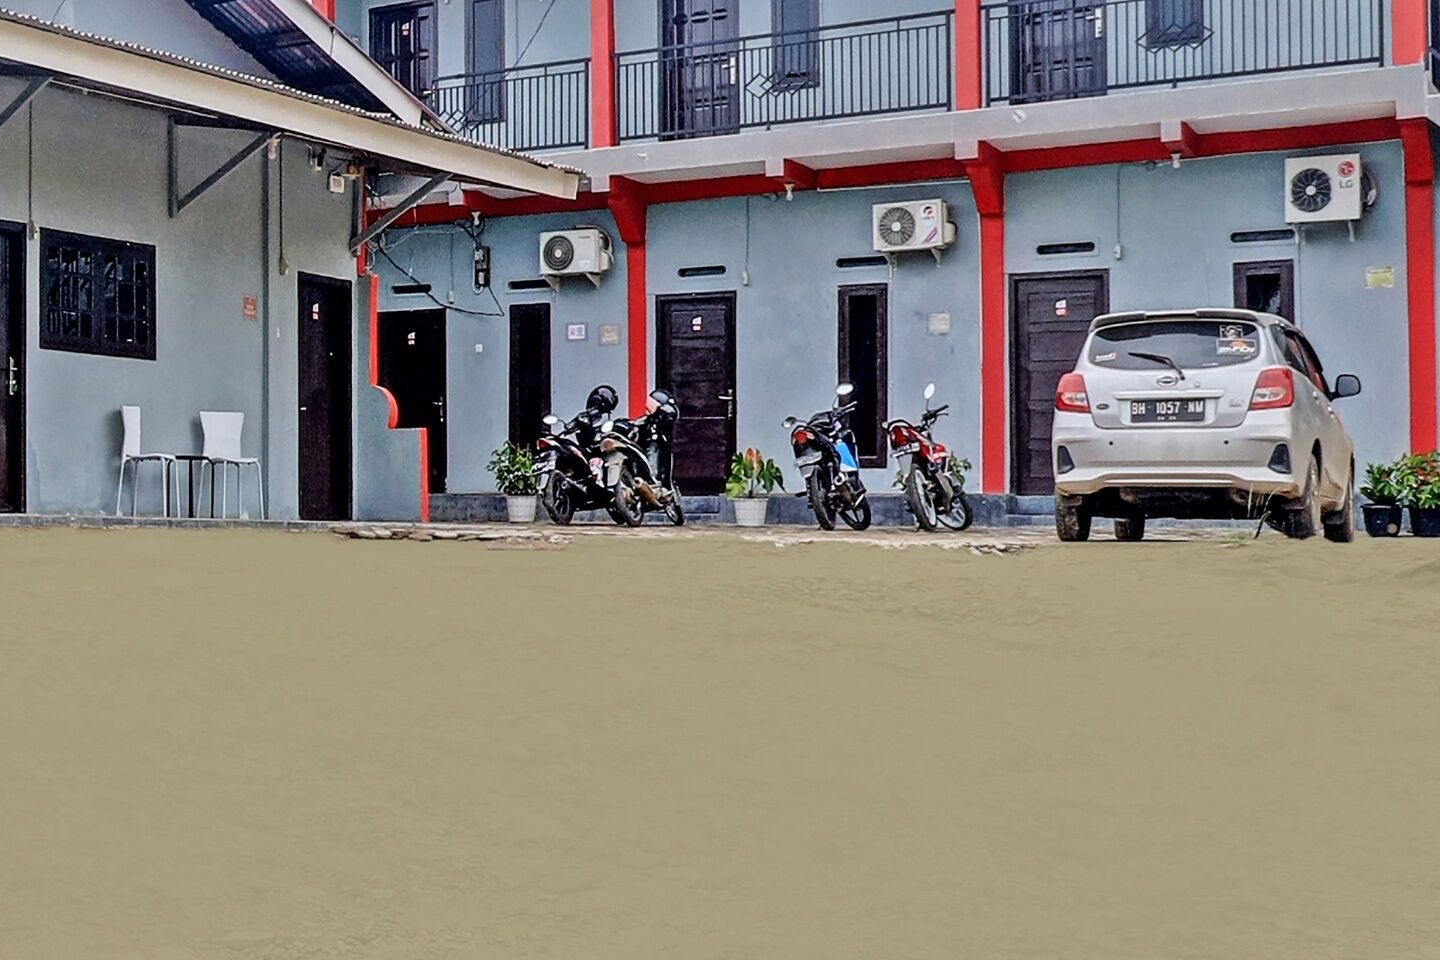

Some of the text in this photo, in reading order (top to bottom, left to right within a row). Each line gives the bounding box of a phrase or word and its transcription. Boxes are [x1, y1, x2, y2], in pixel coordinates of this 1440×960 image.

[1339, 179, 1353, 189] LG
[1131, 402, 1146, 415] BH
[1155, 401, 1181, 415] 1057
